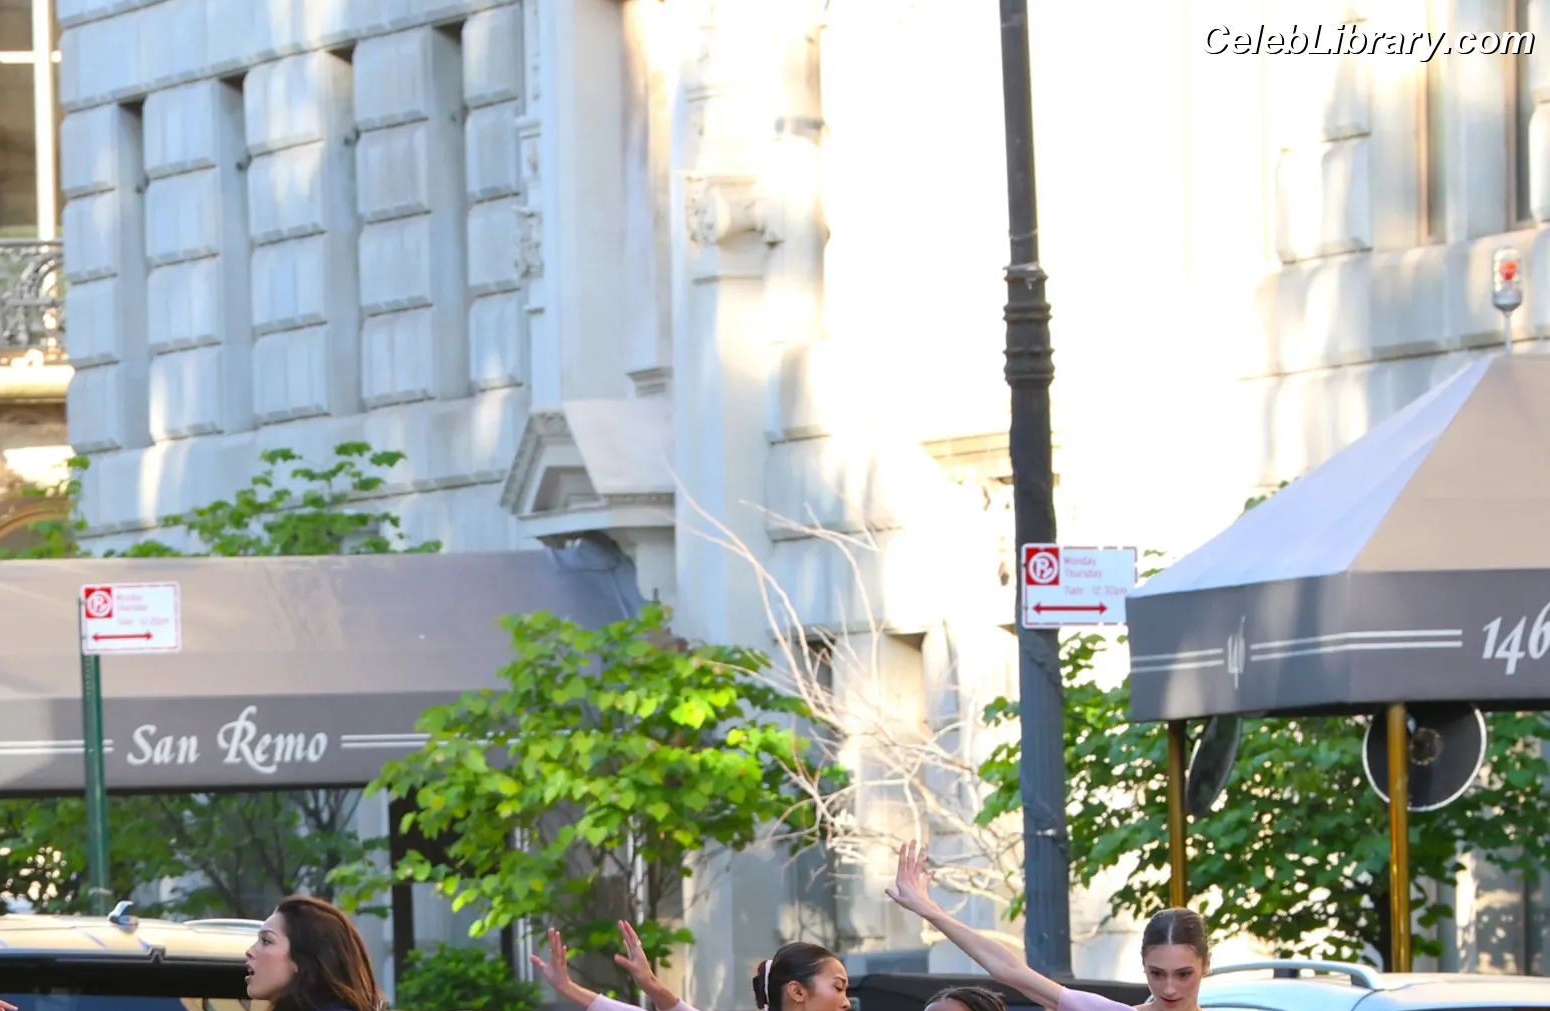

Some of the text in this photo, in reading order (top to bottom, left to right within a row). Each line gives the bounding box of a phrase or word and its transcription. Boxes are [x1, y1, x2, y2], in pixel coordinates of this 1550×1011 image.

[1482, 602, 1550, 676] 146
[126, 705, 328, 774] San Remo
